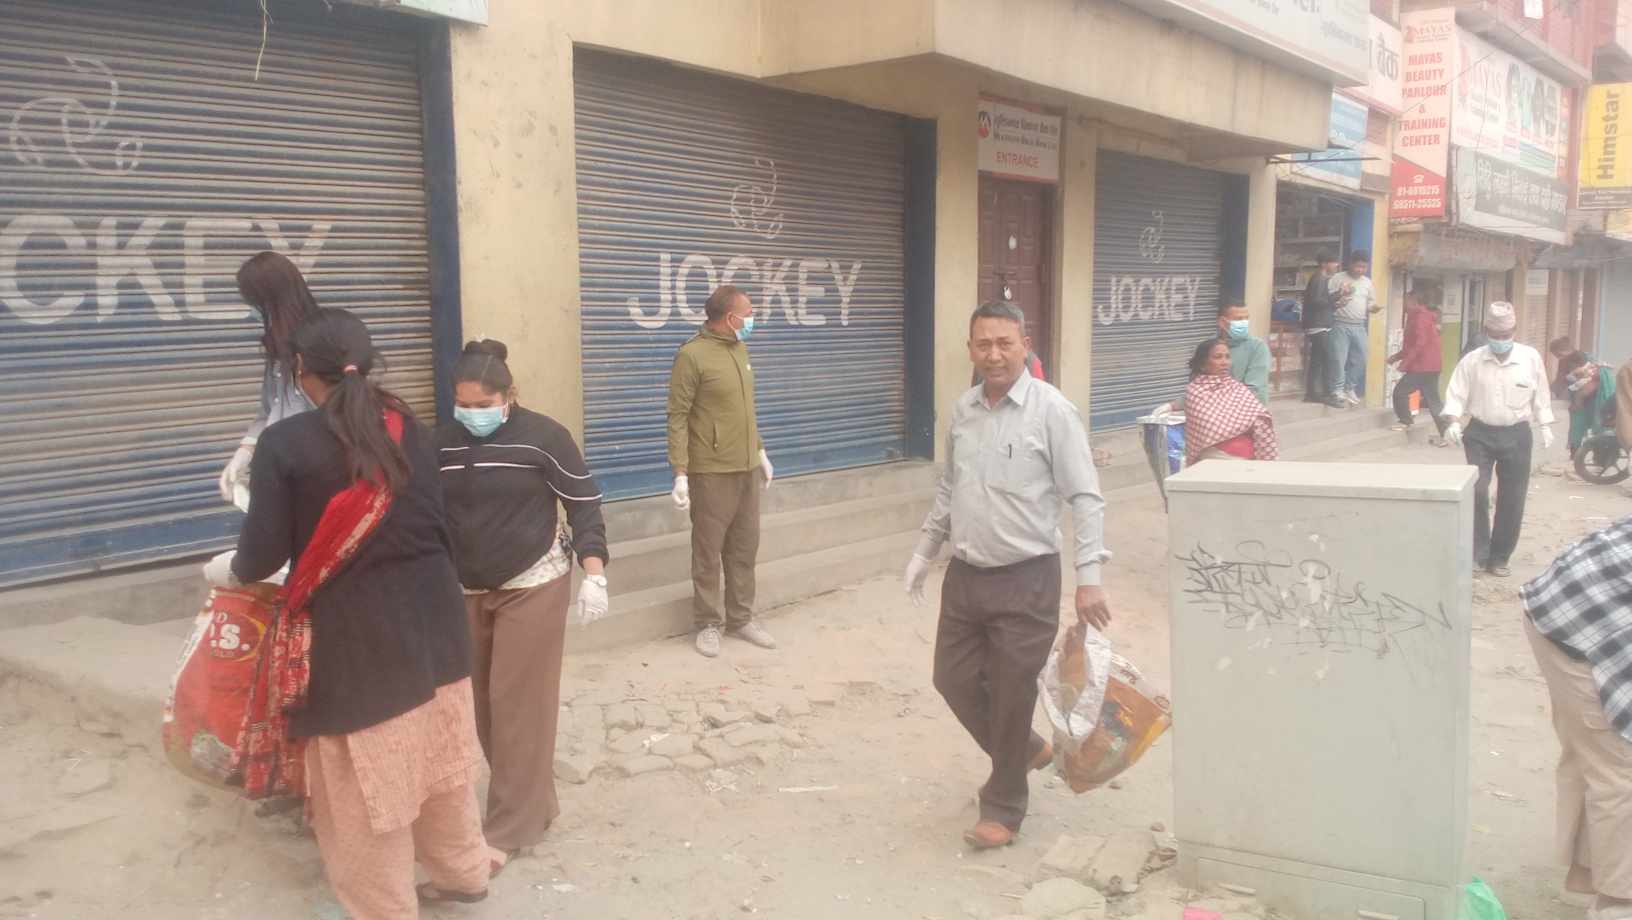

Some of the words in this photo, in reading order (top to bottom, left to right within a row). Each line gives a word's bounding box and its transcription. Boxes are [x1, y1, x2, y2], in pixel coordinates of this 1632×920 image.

[1407, 52, 1443, 66] MAYAS
[1404, 68, 1445, 82] BEAUTY
[1401, 84, 1447, 98] PARLOUR
[1399, 117, 1447, 131] TRAINING
[1401, 134, 1441, 147] CENTER
[1597, 90, 1620, 180] Himstar
[995, 151, 1039, 169] ENTRANCE
[1096, 276, 1200, 325] JOCKEY
